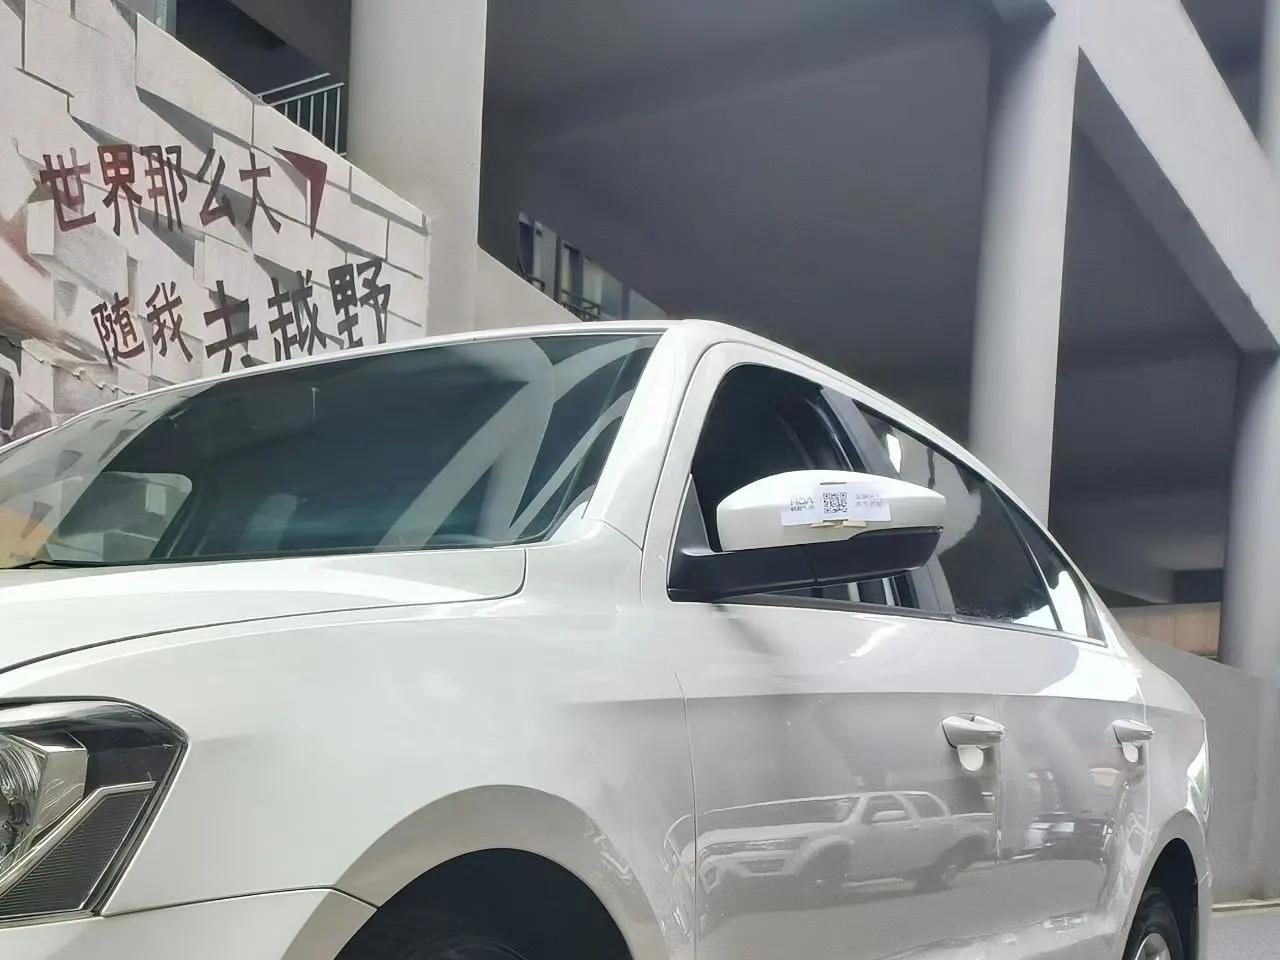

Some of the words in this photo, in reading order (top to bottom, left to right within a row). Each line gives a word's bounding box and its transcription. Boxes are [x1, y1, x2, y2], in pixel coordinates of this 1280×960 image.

[39, 144, 282, 236] 世界那么大
[91, 259, 391, 373] 随我去越野
